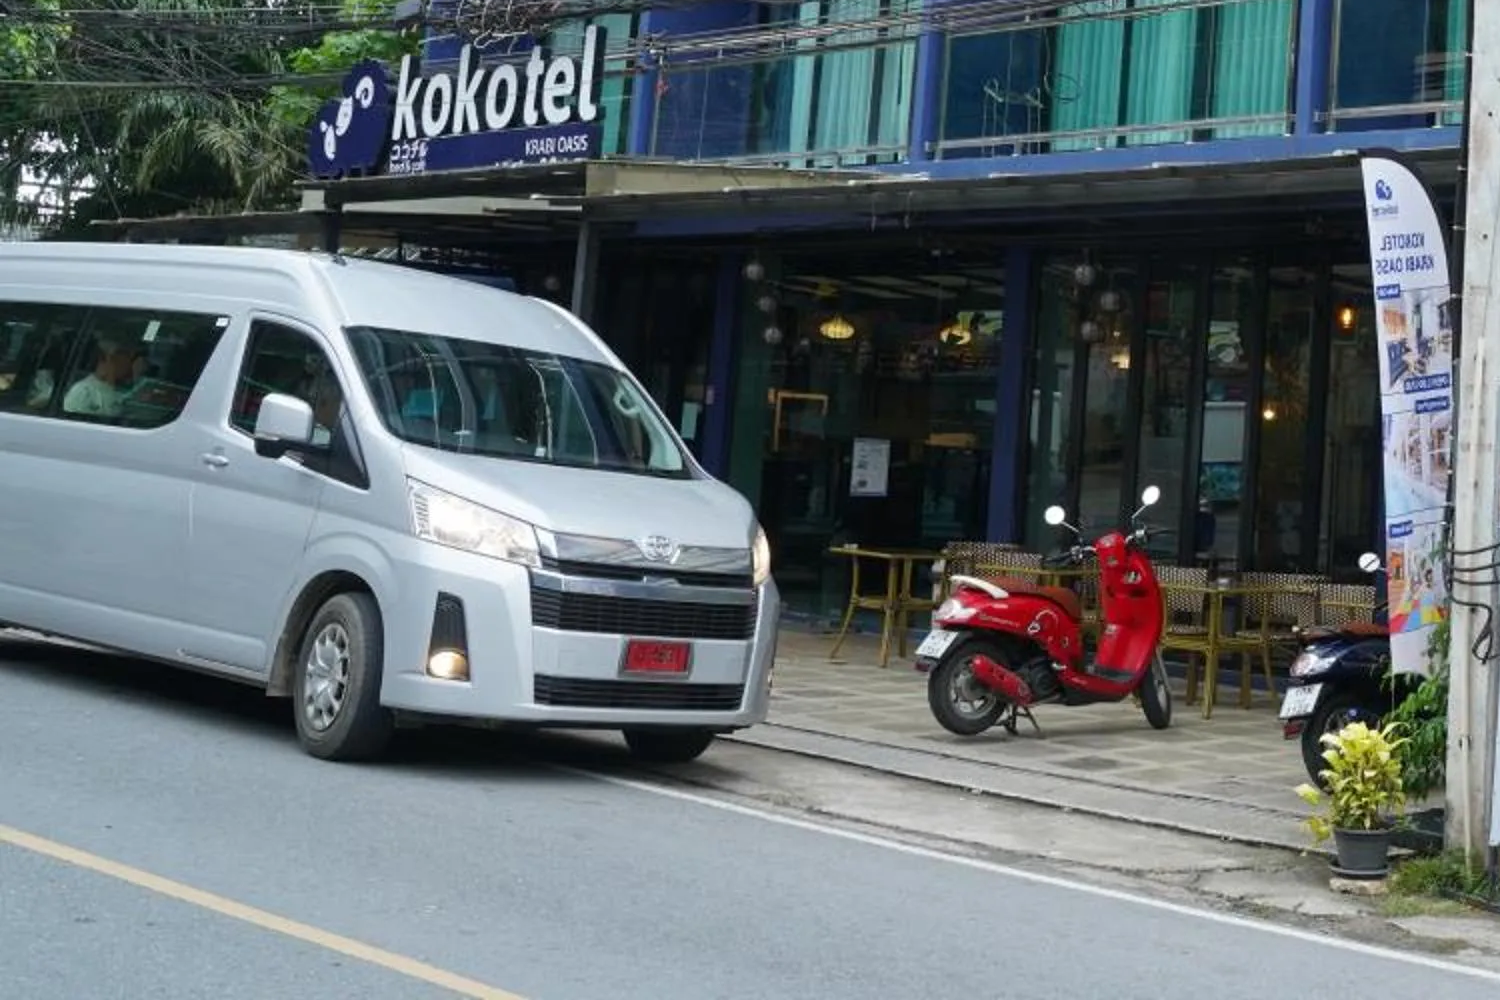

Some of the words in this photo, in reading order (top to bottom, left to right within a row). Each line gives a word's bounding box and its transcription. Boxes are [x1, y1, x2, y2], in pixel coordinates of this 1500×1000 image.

[391, 25, 597, 141] kokotel
[525, 138, 556, 156] KRABI
[557, 134, 589, 153] OASIS
